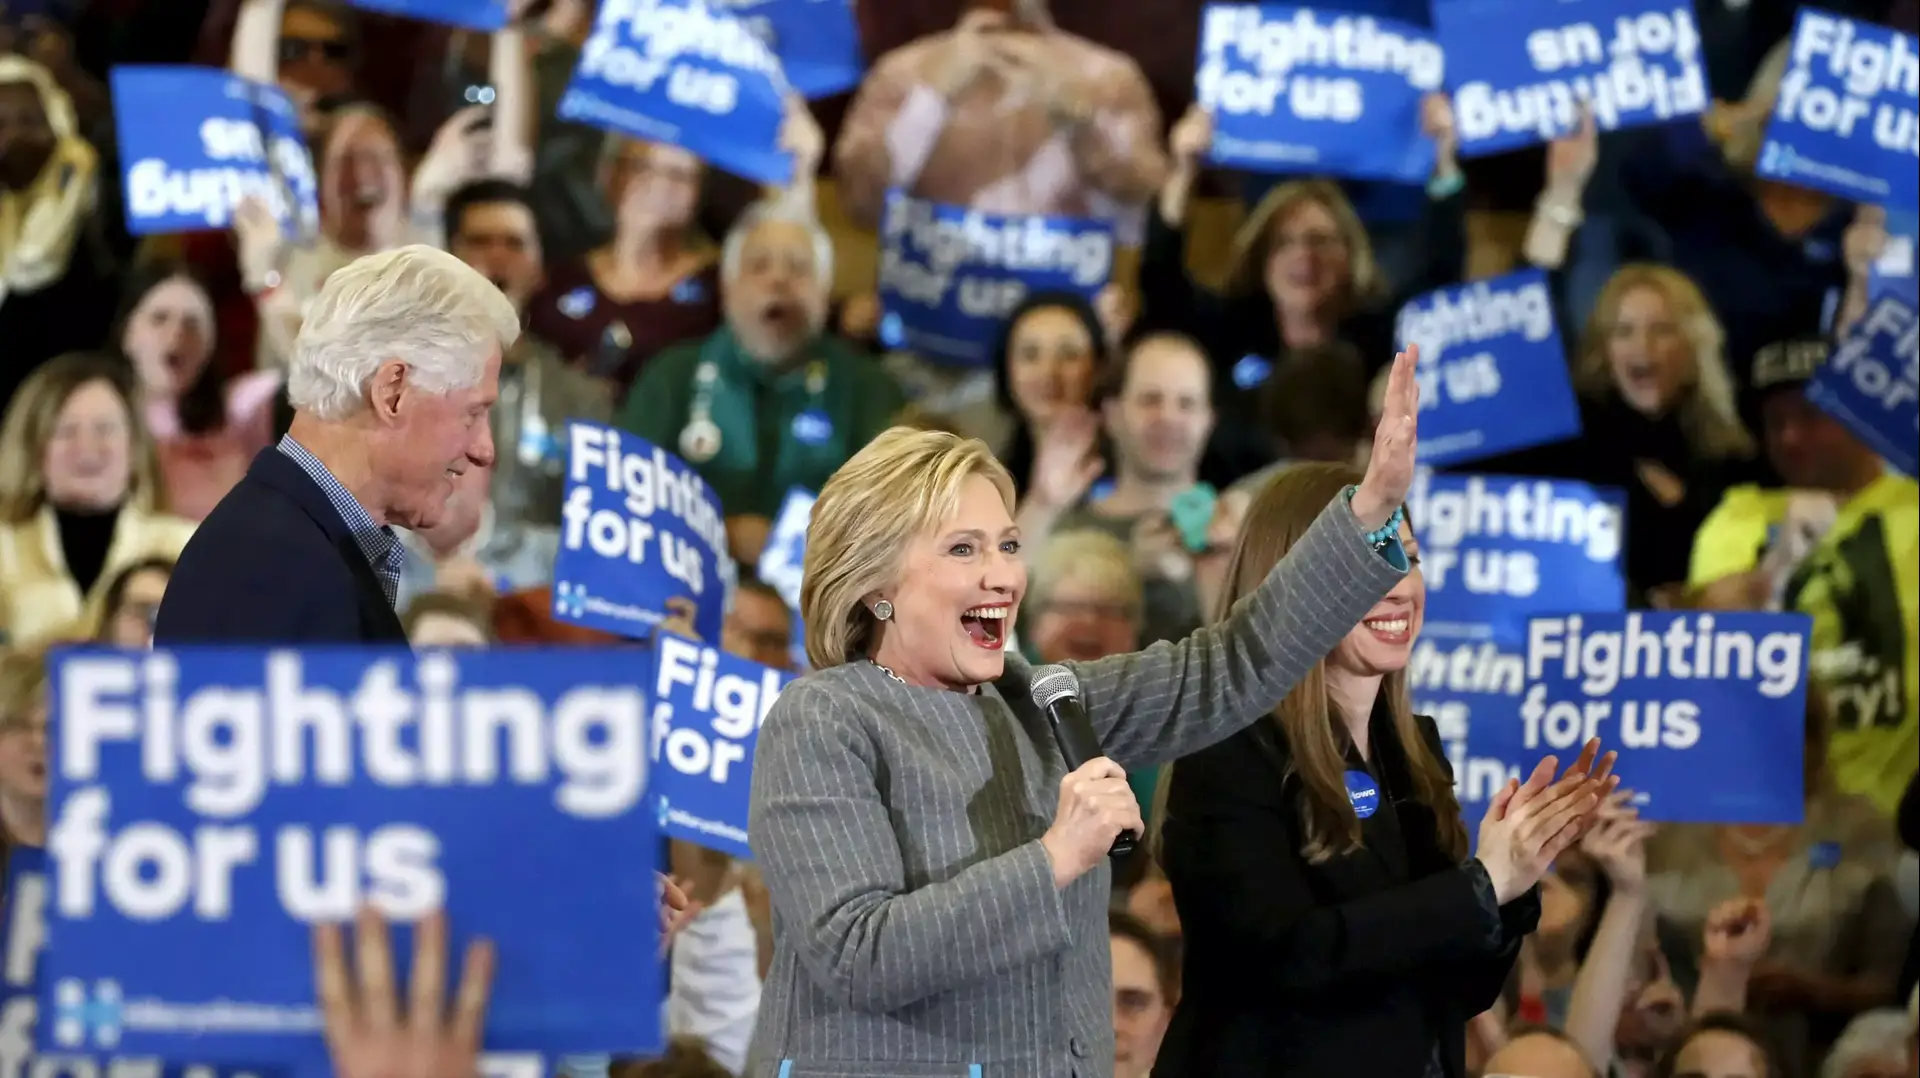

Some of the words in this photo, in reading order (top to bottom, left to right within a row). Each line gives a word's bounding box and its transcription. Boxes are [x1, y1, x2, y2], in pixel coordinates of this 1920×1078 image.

[1203, 5, 1443, 91] Fighting
[1526, 22, 1602, 72] us
[1196, 60, 1286, 116] for
[1291, 75, 1363, 124] us
[1778, 66, 1870, 138] for
[562, 485, 655, 564] for
[570, 422, 738, 612] Fighting
[1463, 548, 1540, 598] us
[1527, 612, 1802, 699] Fighting
[60, 650, 649, 818] Fighting
[651, 702, 745, 784] for
[1519, 683, 1612, 750] for
[1620, 699, 1702, 750] us
[48, 786, 259, 922] for
[277, 823, 448, 924] us
